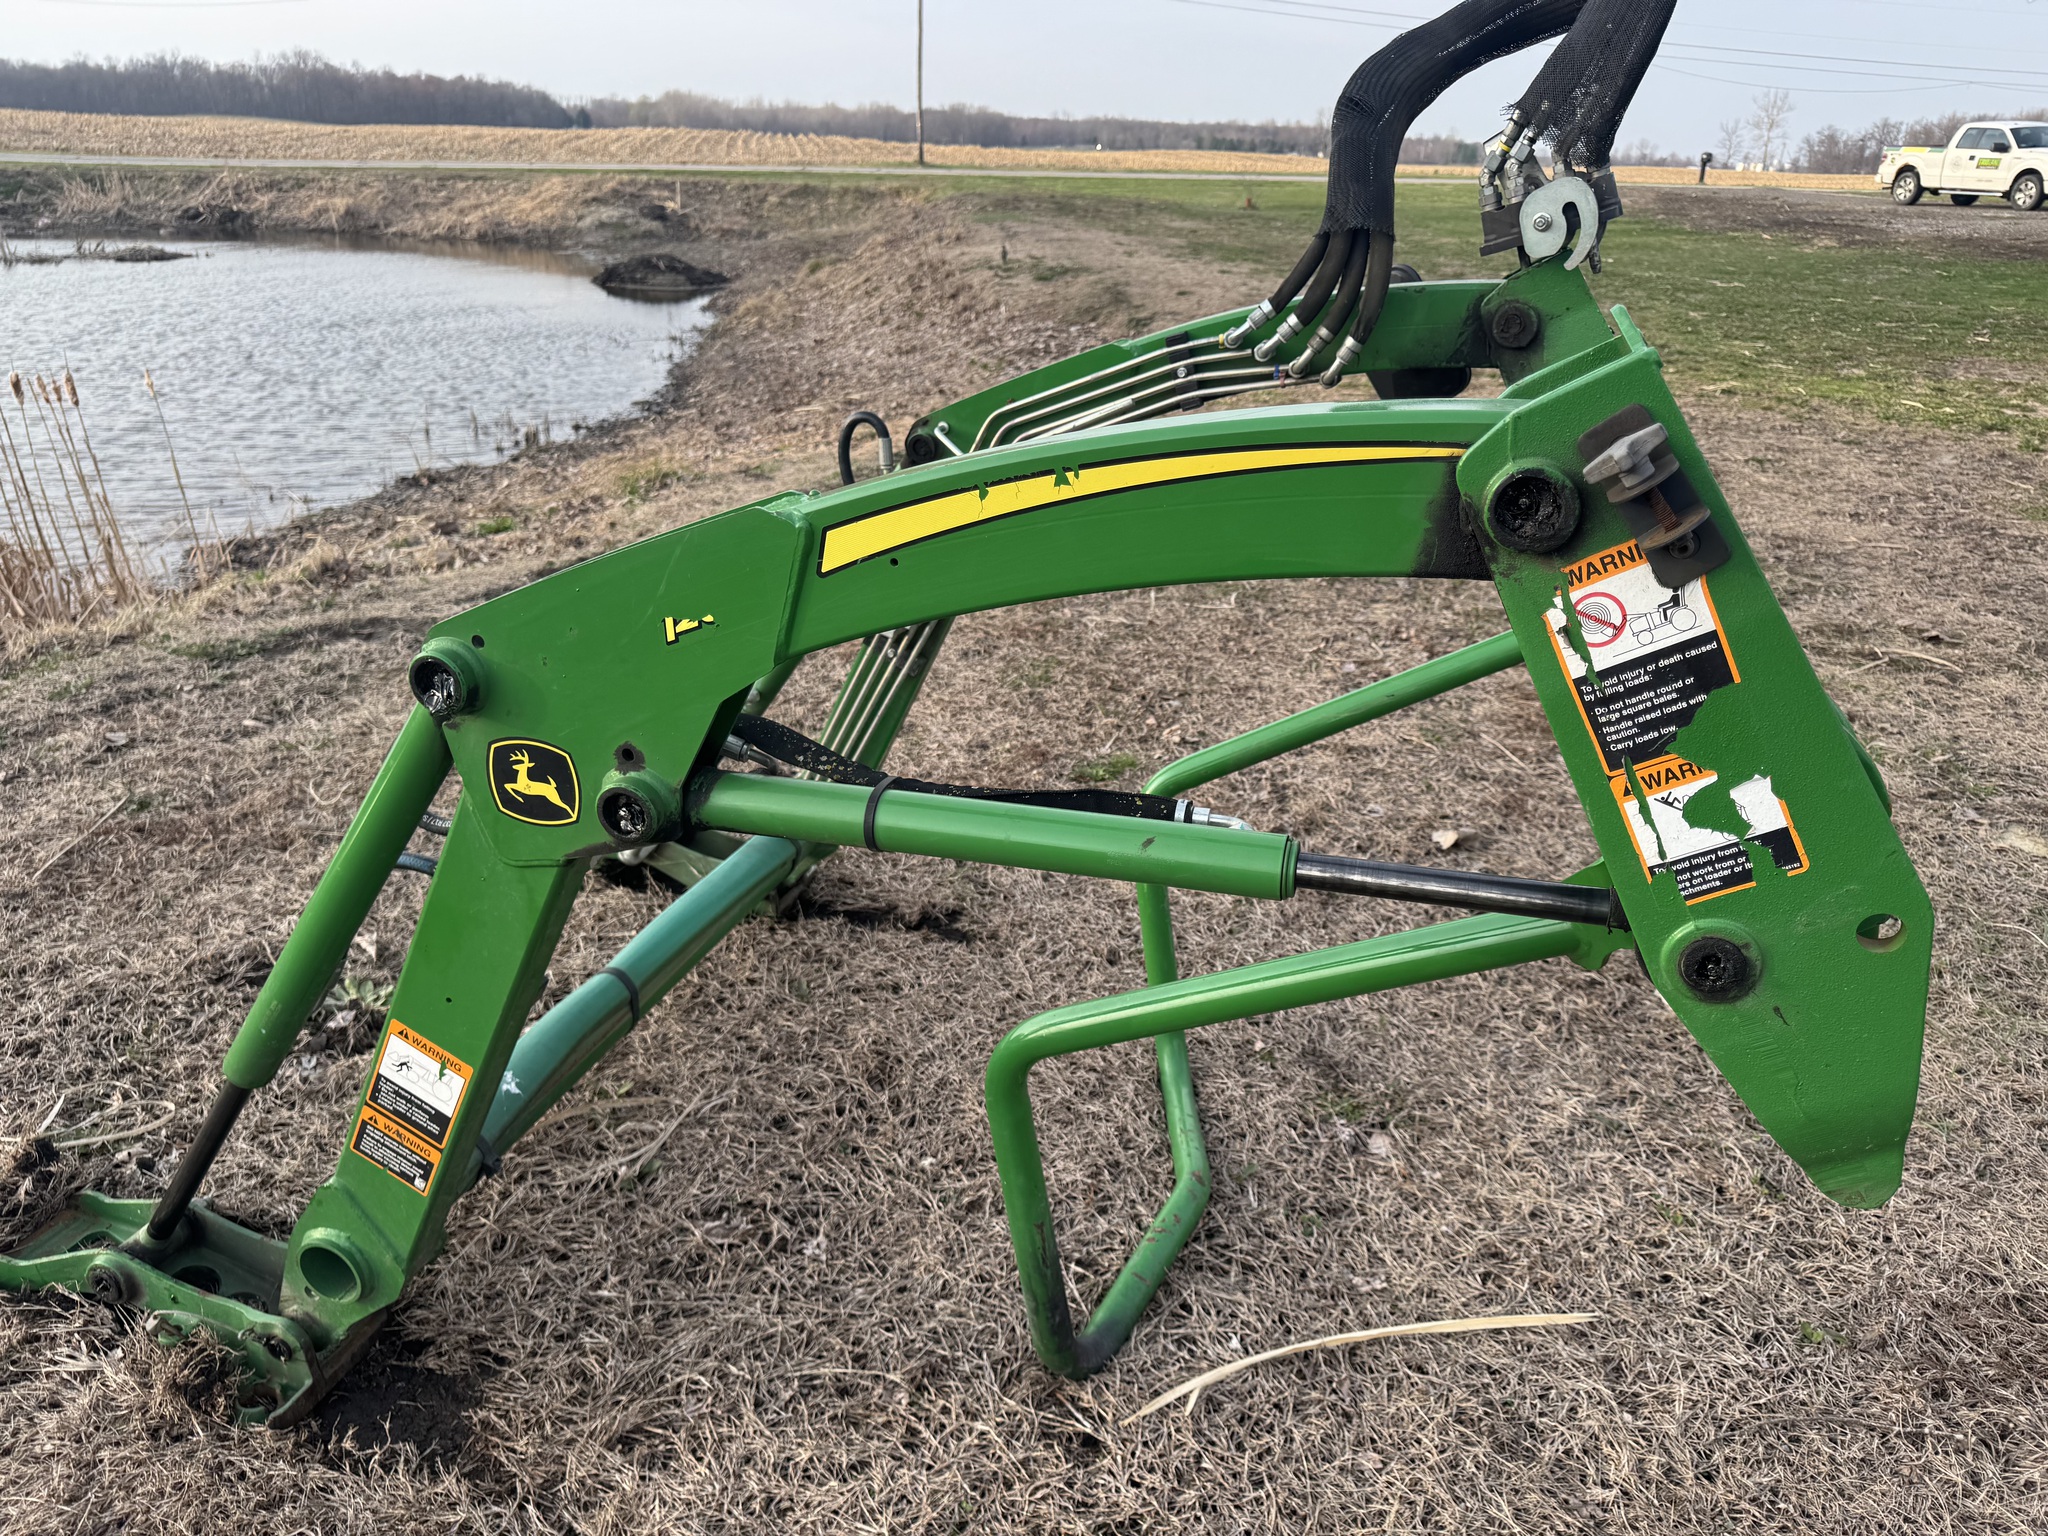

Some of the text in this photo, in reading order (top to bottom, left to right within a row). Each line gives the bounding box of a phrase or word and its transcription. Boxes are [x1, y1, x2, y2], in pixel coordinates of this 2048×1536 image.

[1619, 668, 1644, 681] injury
[1658, 654, 1683, 667] death
[1685, 641, 1717, 657] caused
[1610, 701, 1624, 711] not
[1625, 692, 1655, 705] handle
[1657, 680, 1683, 694] round
[1625, 675, 1652, 688] loads:
[1598, 693, 1679, 723] large square bales.
[1603, 694, 1707, 734] Handle raised loads with
[1607, 728, 1640, 741] caution.
[1610, 725, 1678, 751] Carry loads low.
[1672, 860, 1690, 870] void
[1691, 854, 1715, 865] injury
[1718, 848, 1738, 857] from
[1677, 872, 1691, 881] not
[1692, 866, 1714, 876] work
[1715, 860, 1735, 870] from
[1705, 869, 1731, 880] loader
[412, 1035, 462, 1073] WARNING
[383, 1122, 431, 1158] WARNING
